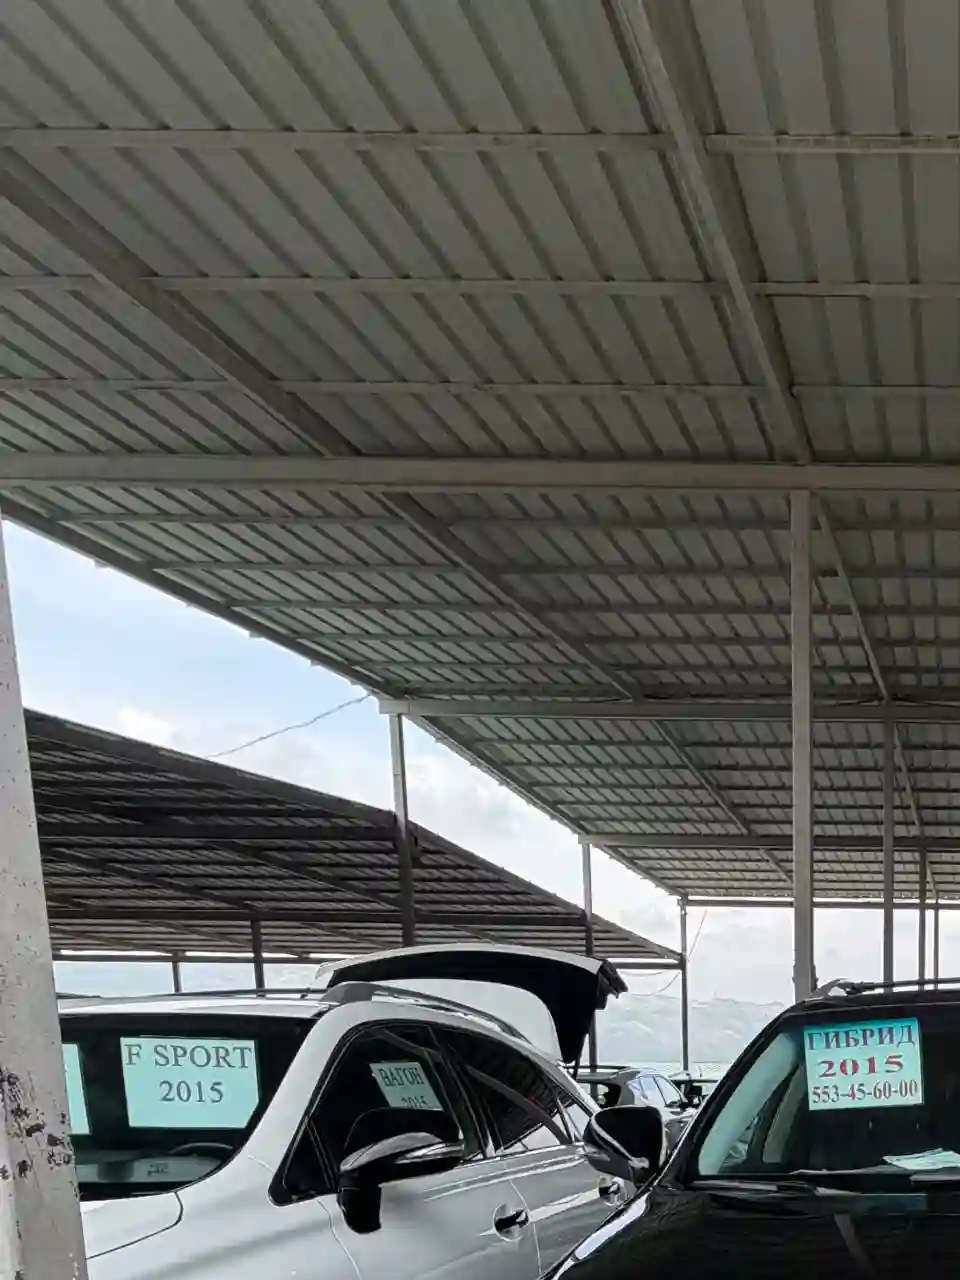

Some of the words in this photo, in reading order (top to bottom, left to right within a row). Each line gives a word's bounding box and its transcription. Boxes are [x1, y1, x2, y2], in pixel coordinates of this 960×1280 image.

[807, 1025, 916, 1050] ГИБРИД
[124, 1044, 142, 1065] F
[153, 1044, 252, 1069] SPORT
[817, 1055, 905, 1078] 2015
[159, 1080, 224, 1103] 2015
[812, 1079, 918, 1104] 553-45-60-00
